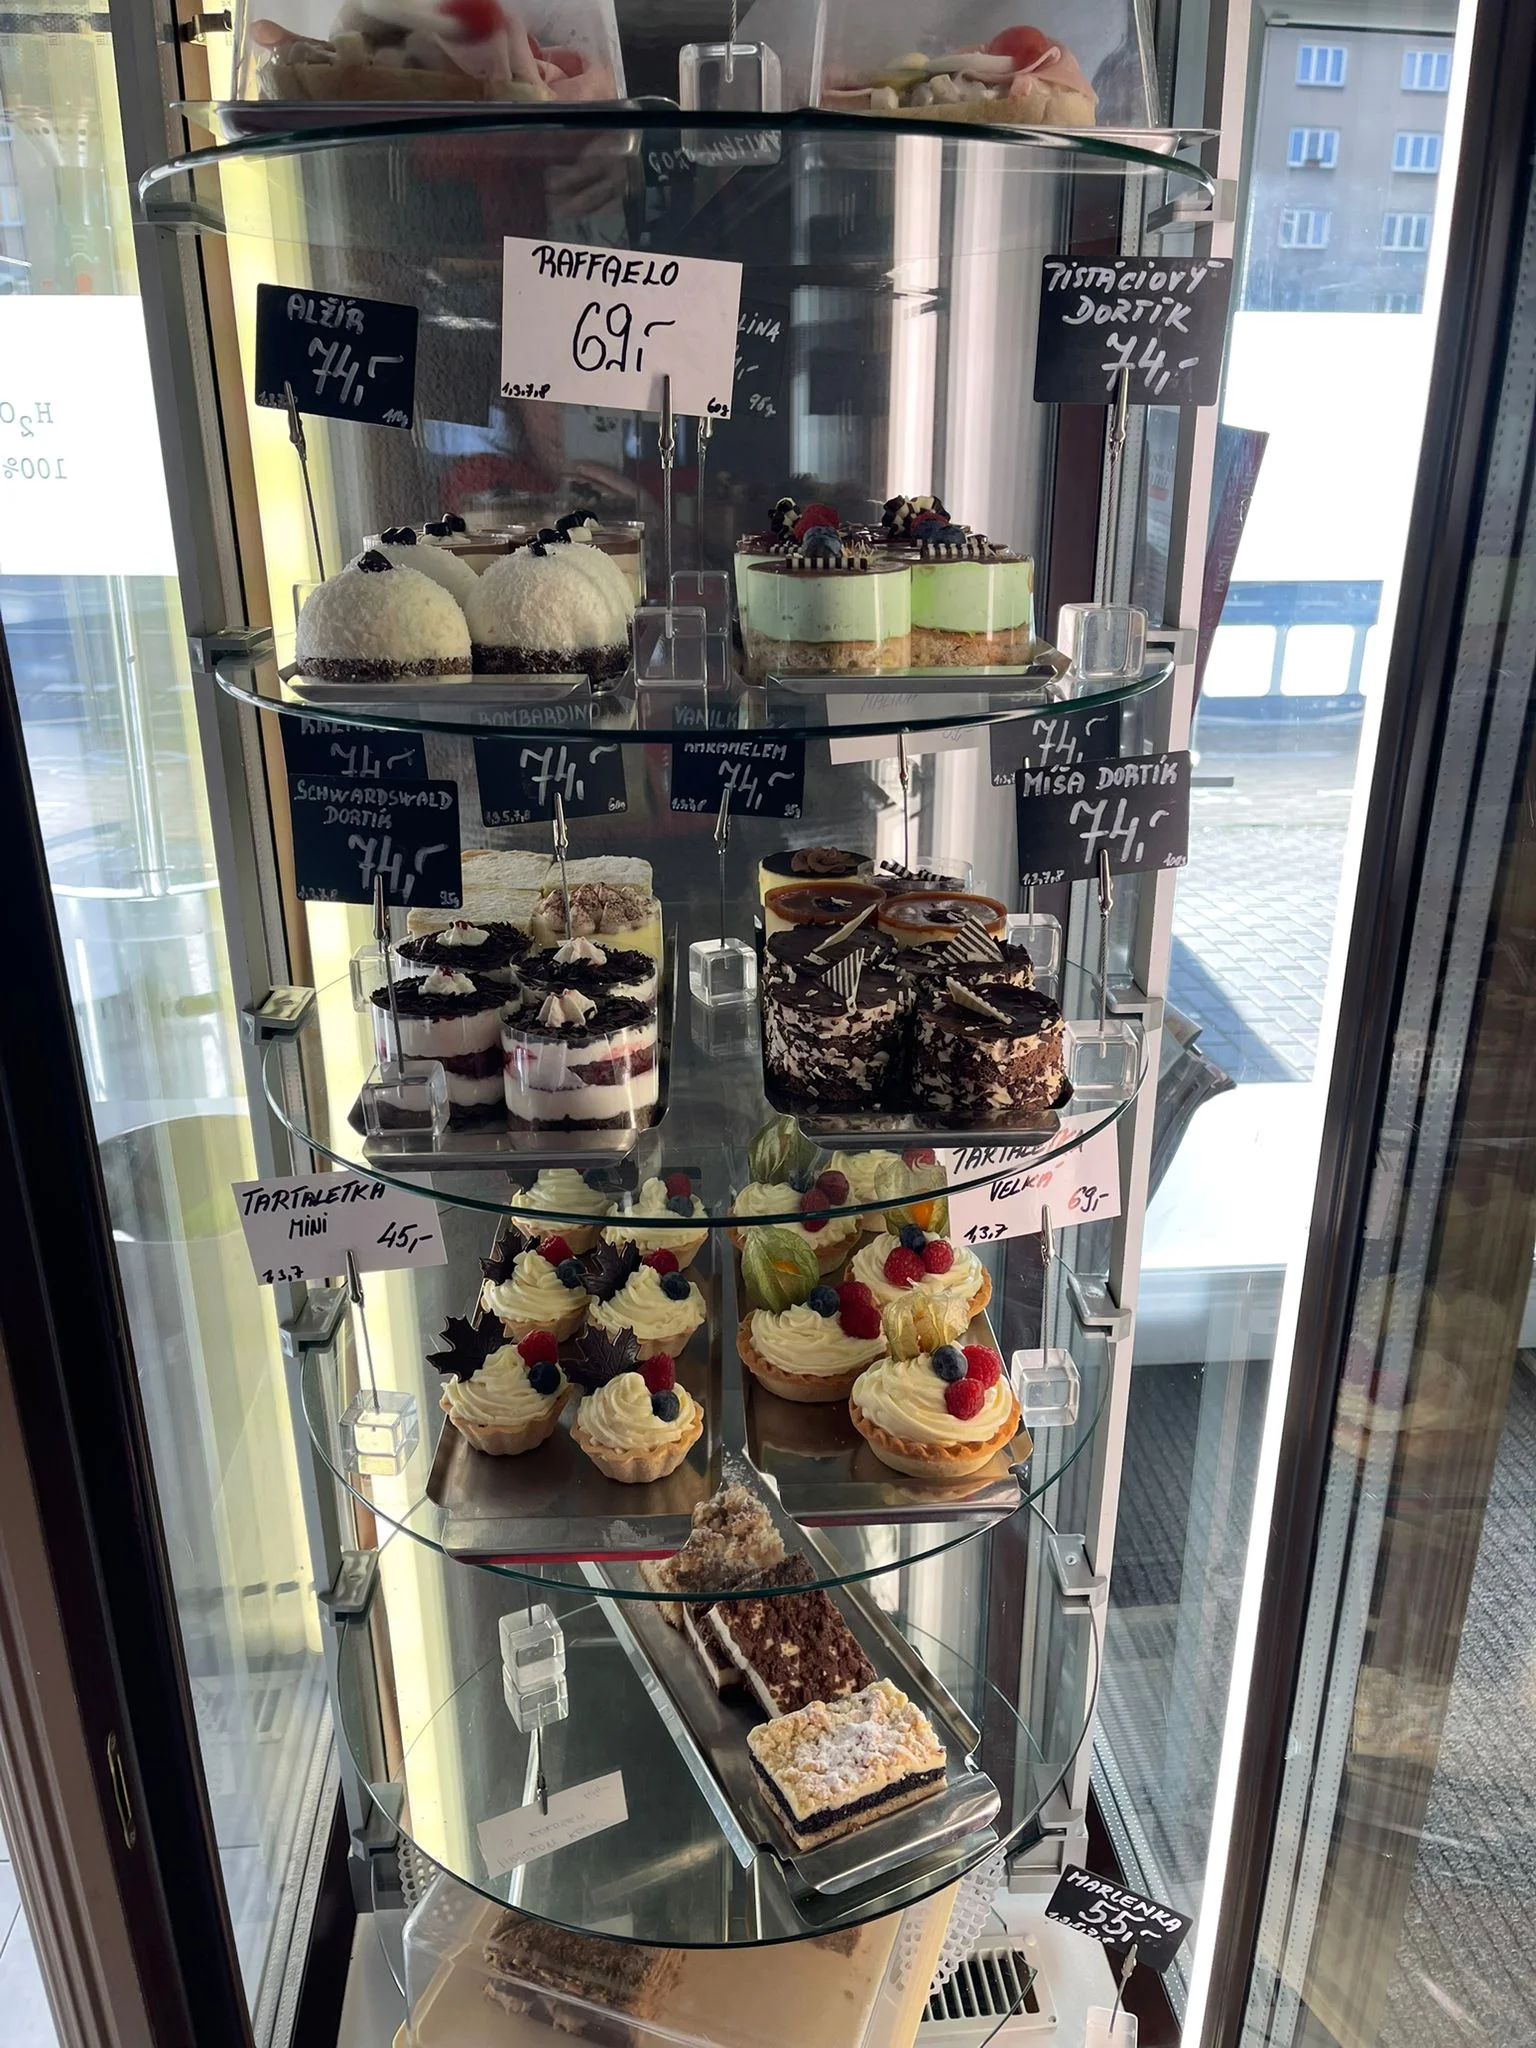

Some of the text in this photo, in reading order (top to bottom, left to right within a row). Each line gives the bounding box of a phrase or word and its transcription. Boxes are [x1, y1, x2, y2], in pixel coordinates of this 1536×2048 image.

[532, 245, 679, 287] RAFFAELO
[287, 293, 365, 335] ALŽÍR
[1062, 296, 1192, 333] DORTÍK
[308, 337, 404, 406] 74,-
[1101, 332, 1200, 396] 74,-
[520, 744, 618, 806] 74,-
[1023, 755, 1178, 797] MÍŠA DORTÍK
[1070, 798, 1170, 864] 74,-
[348, 834, 449, 905] 74,-
[243, 1179, 386, 1216] TARTALETKA
[377, 1221, 433, 1253] 45,-
[1066, 1871, 1183, 1933] MARLENKA
